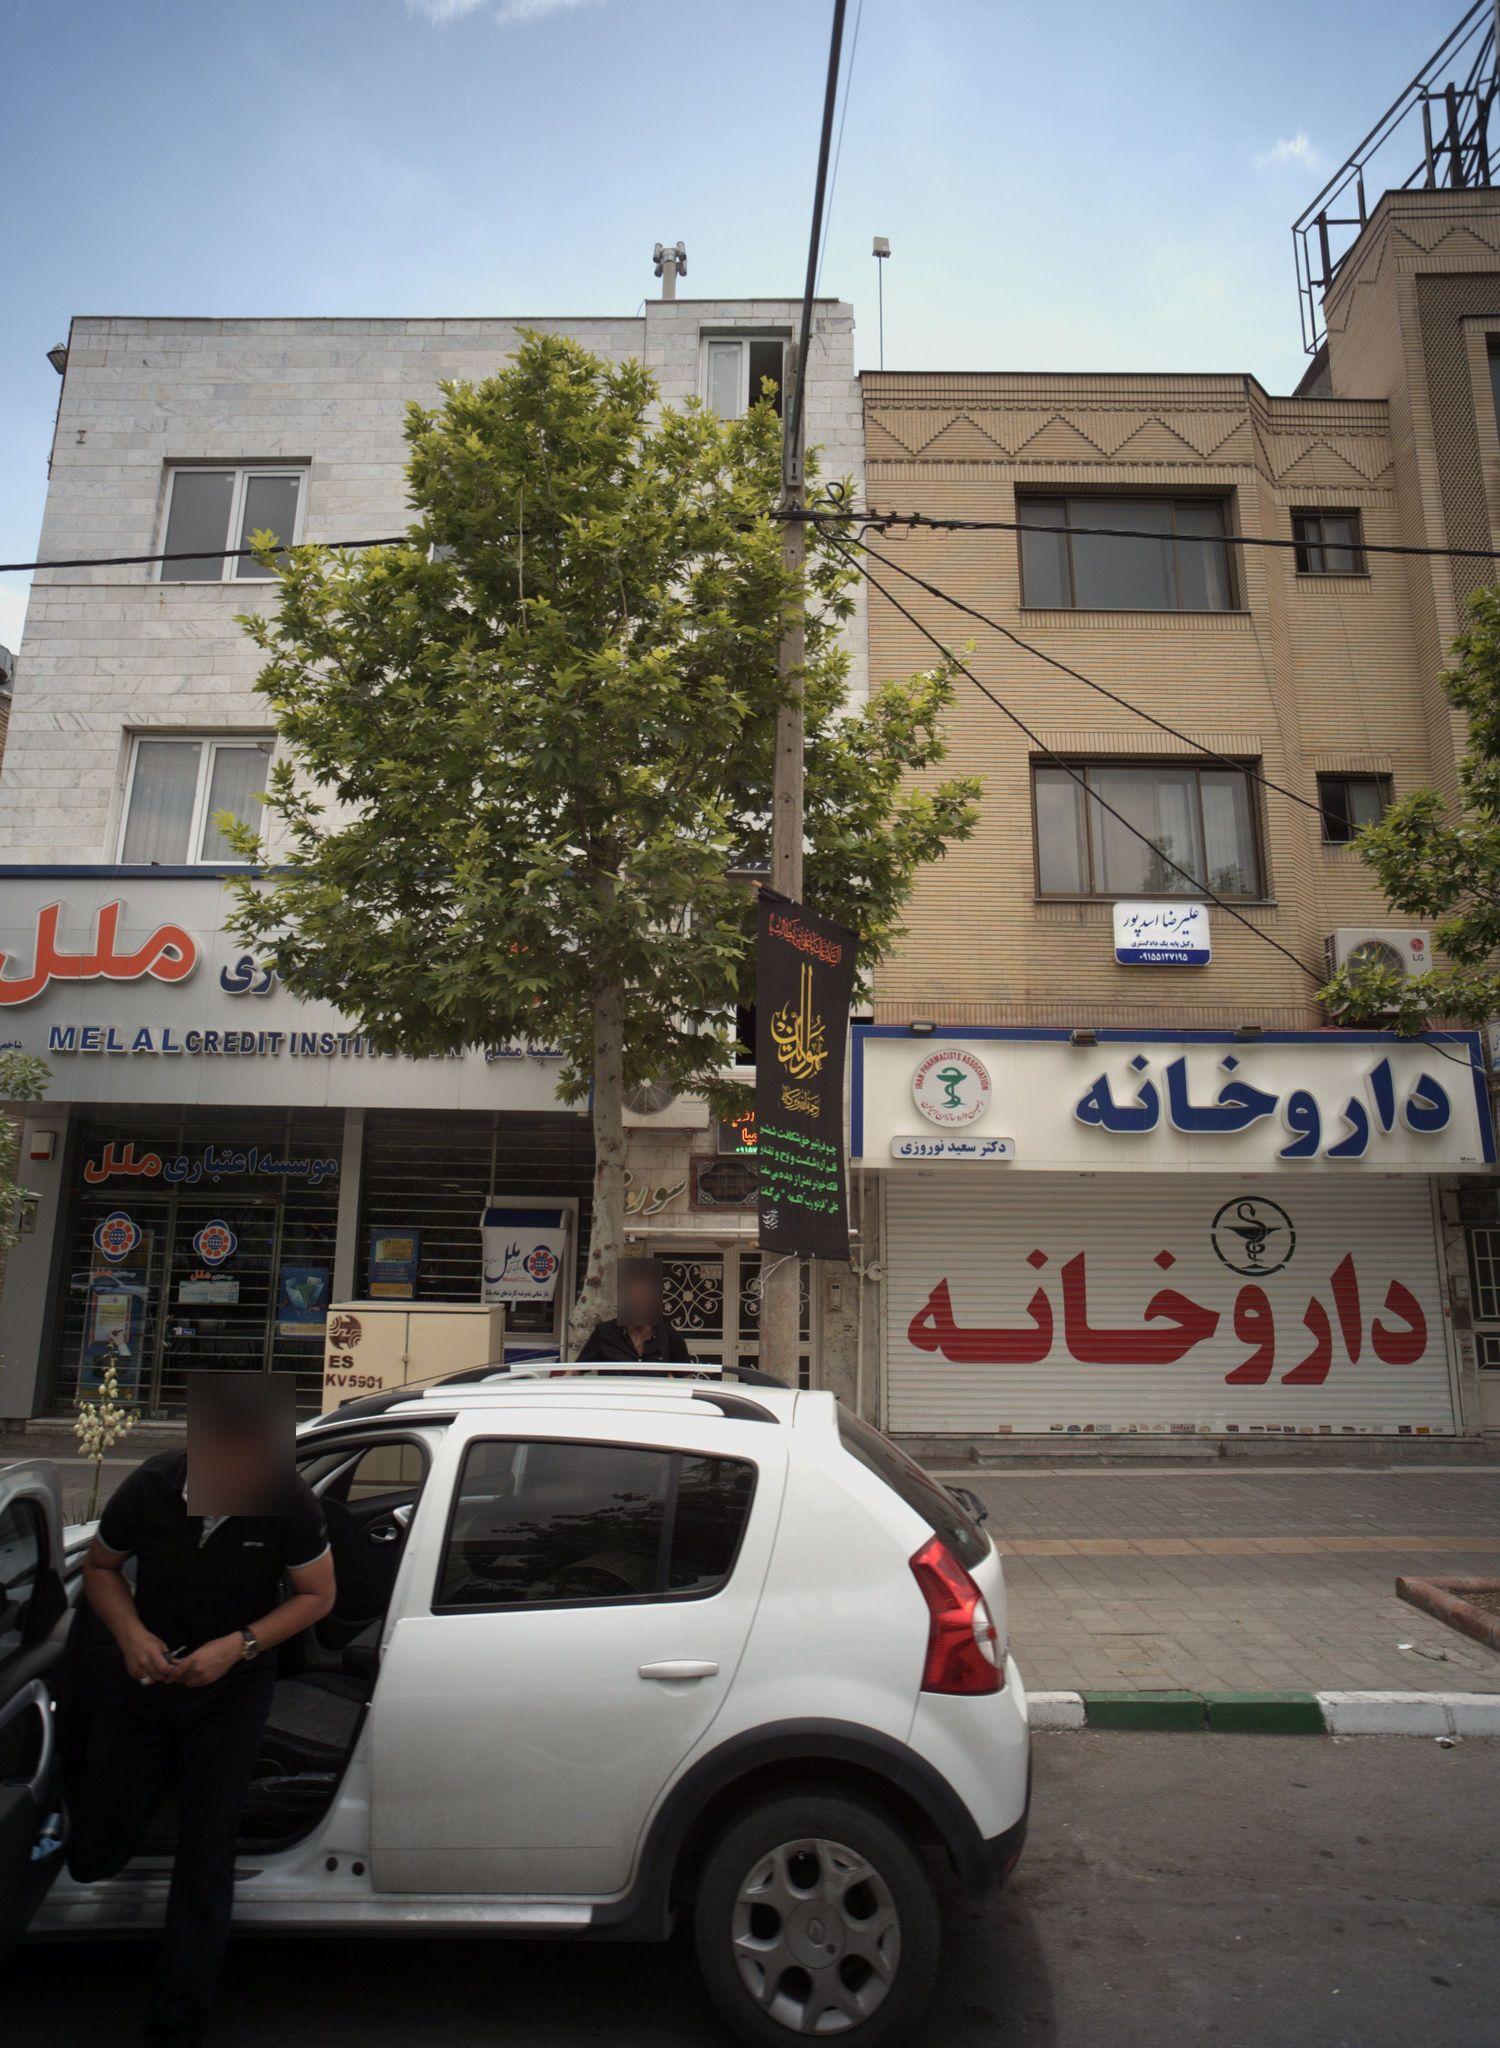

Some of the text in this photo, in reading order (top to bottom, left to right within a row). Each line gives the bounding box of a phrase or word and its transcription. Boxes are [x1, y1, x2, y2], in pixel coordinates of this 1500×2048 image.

[1162, 907, 1199, 935] علیرضا
[0, 900, 200, 1006] ملل
[49, 1026, 180, 1052] MELAL
[184, 1030, 284, 1055] CREDIT
[915, 1051, 989, 1091] IRAN PHARMACISTS ASSOCIATION
[1073, 1053, 1453, 1160] داروخانه
[84, 1141, 338, 1184] موسسه اعتباری ملل
[900, 1140, 1006, 1156] دکتر سعید نوروزی
[908, 1249, 1428, 1386] داروخانه
[328, 1355, 354, 1369] ES
[325, 1374, 384, 1390] KV5901
